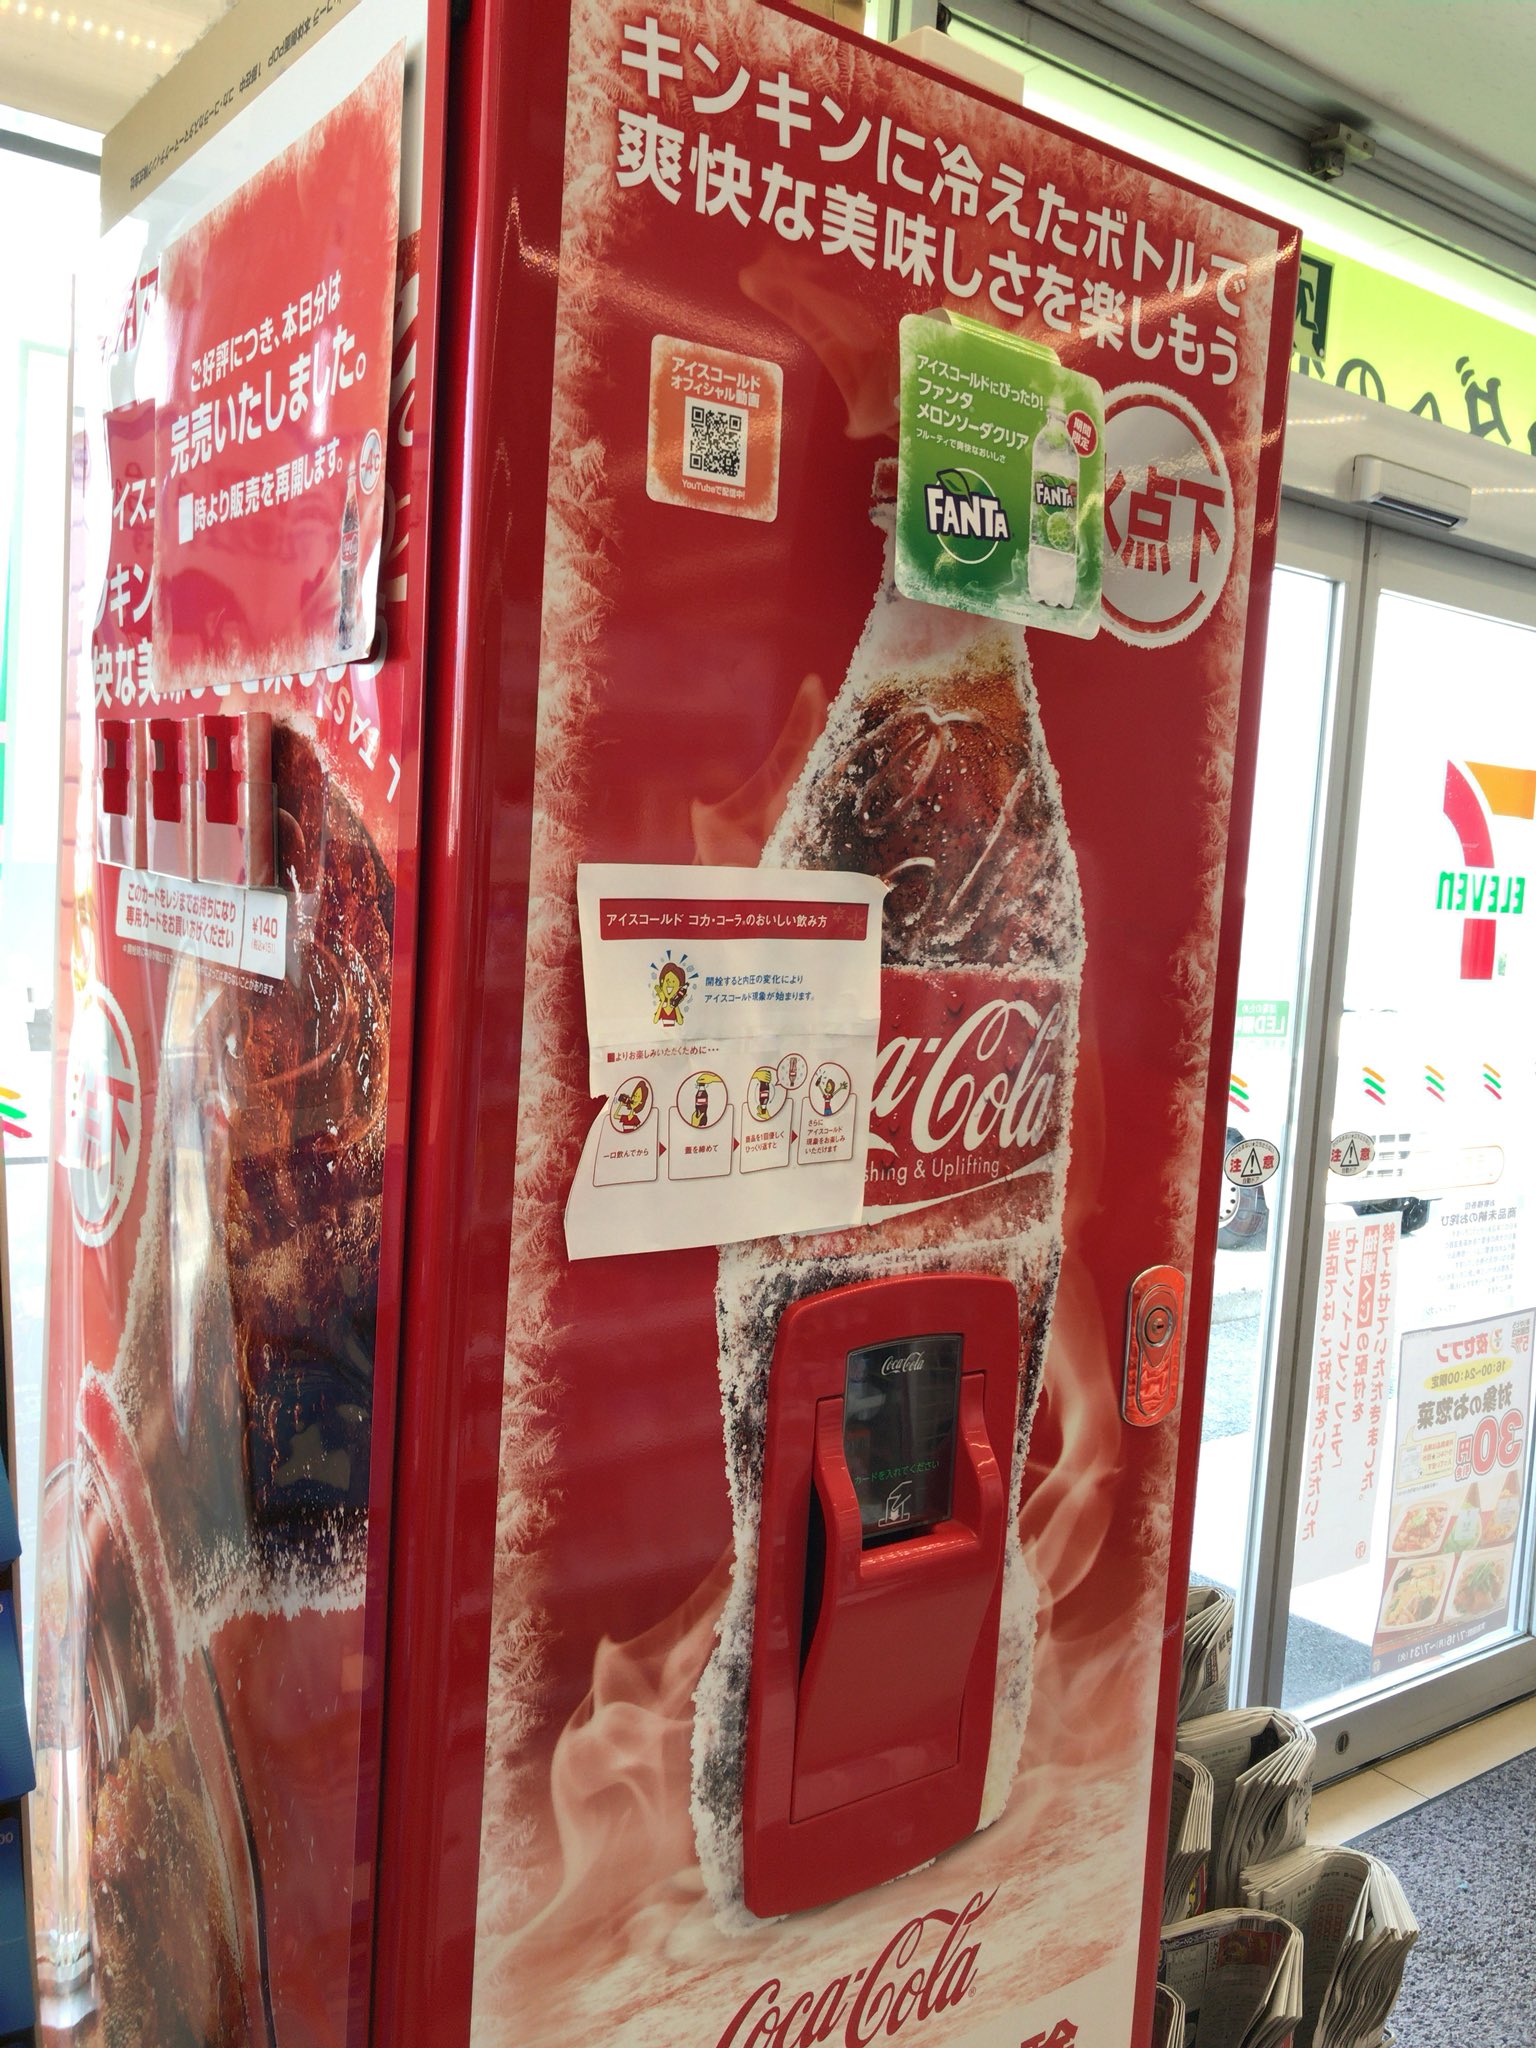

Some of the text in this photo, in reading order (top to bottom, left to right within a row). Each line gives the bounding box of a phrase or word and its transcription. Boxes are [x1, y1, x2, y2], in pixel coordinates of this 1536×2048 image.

[620, 16, 1248, 317] キンキンに冷えたボトルで
[617, 110, 1240, 385] 爽快な美味しさを楽しもう
[191, 270, 342, 393] ご好評につき、本日分は
[671, 356, 761, 391] アイスコールド
[917, 354, 1044, 412] アイスコールドにぴったり!
[170, 325, 367, 479] 完売いたしました。
[671, 375, 760, 408] オフィシャル動画
[917, 377, 974, 410] ファンタ
[916, 403, 1030, 451] メロンソーダクリア
[1073, 416, 1093, 439] 期間
[1071, 431, 1090, 451] 限定
[193, 437, 343, 532] 時より販売を再開します。
[1035, 482, 1075, 507] FANTA
[925, 485, 1010, 541] FANTA
[127, 883, 236, 923] このカードをレジまでお持ちになり
[252, 915, 278, 940] ¥140
[606, 912, 684, 927] アイスコールド
[705, 974, 804, 987] 開栓すると内圧の変化により
[704, 991, 814, 1004] アイスコールド現象が始まります。
[807, 1127, 844, 1136] アイスコールド
[808, 1119, 824, 1127] さらに
[603, 1147, 649, 1159] 一口飲んでから
[805, 1145, 838, 1154] いただけます
[1331, 1146, 1371, 1163] 注 意
[913, 1159, 926, 1179] &
[932, 1154, 1000, 1182] Uplifting
[1229, 1154, 1275, 1173] 注 意
[881, 1352, 925, 1376] Coca-Cola
